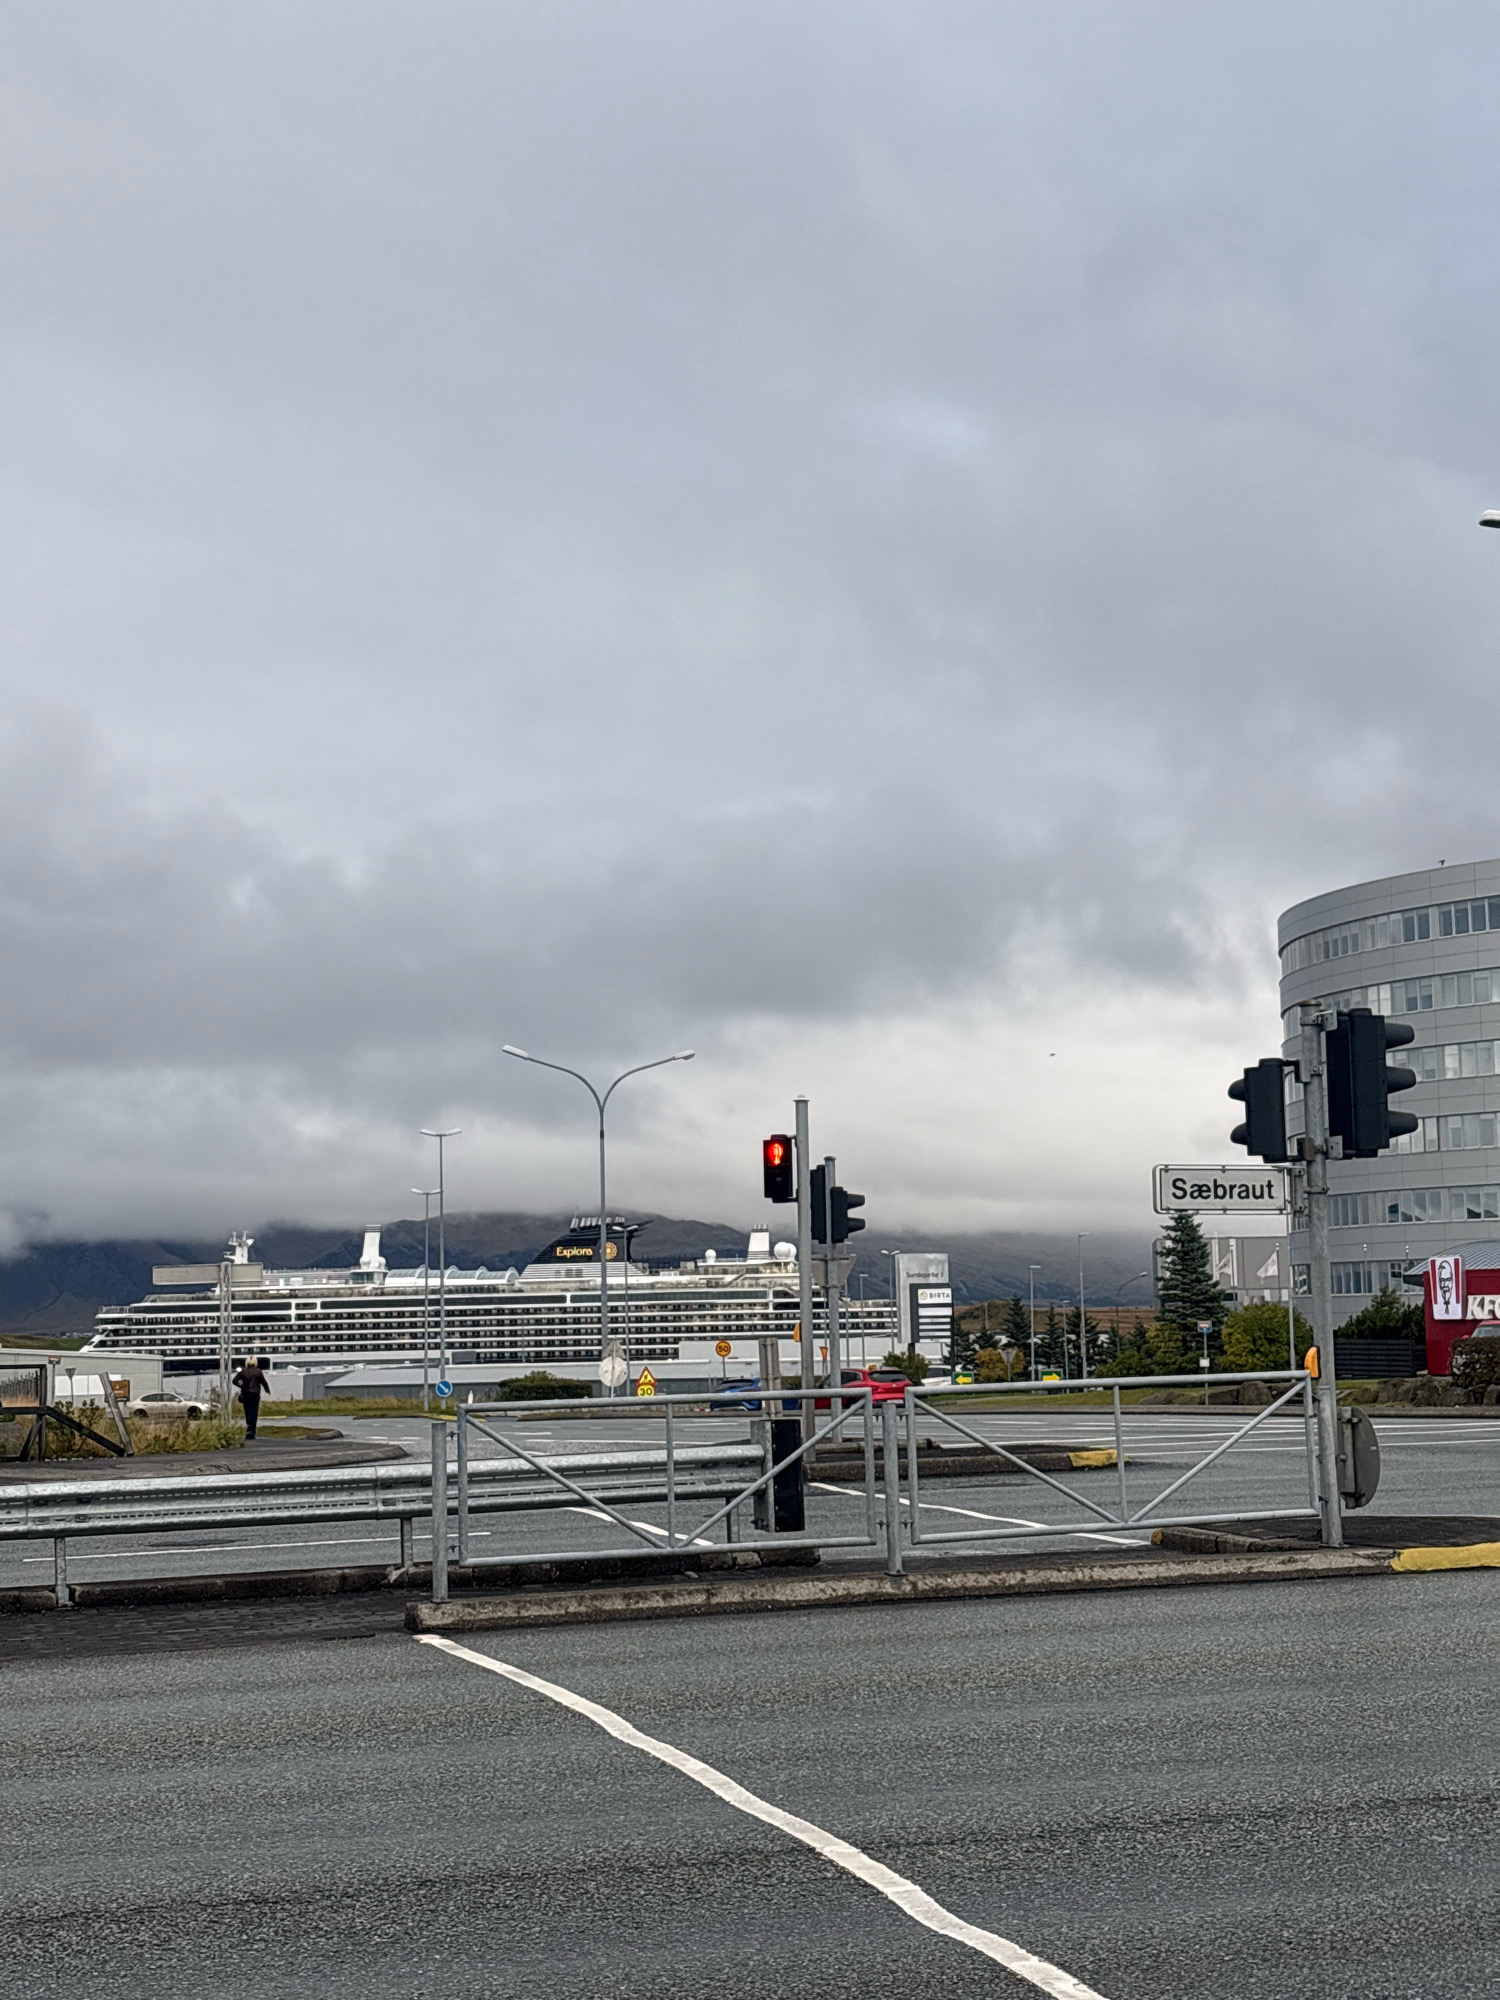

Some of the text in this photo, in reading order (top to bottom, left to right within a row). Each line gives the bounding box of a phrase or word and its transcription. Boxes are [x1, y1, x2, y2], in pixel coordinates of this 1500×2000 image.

[1171, 1177, 1275, 1200] Sæbraut
[556, 1246, 594, 1259] Explora
[639, 1387, 653, 1397] 30
